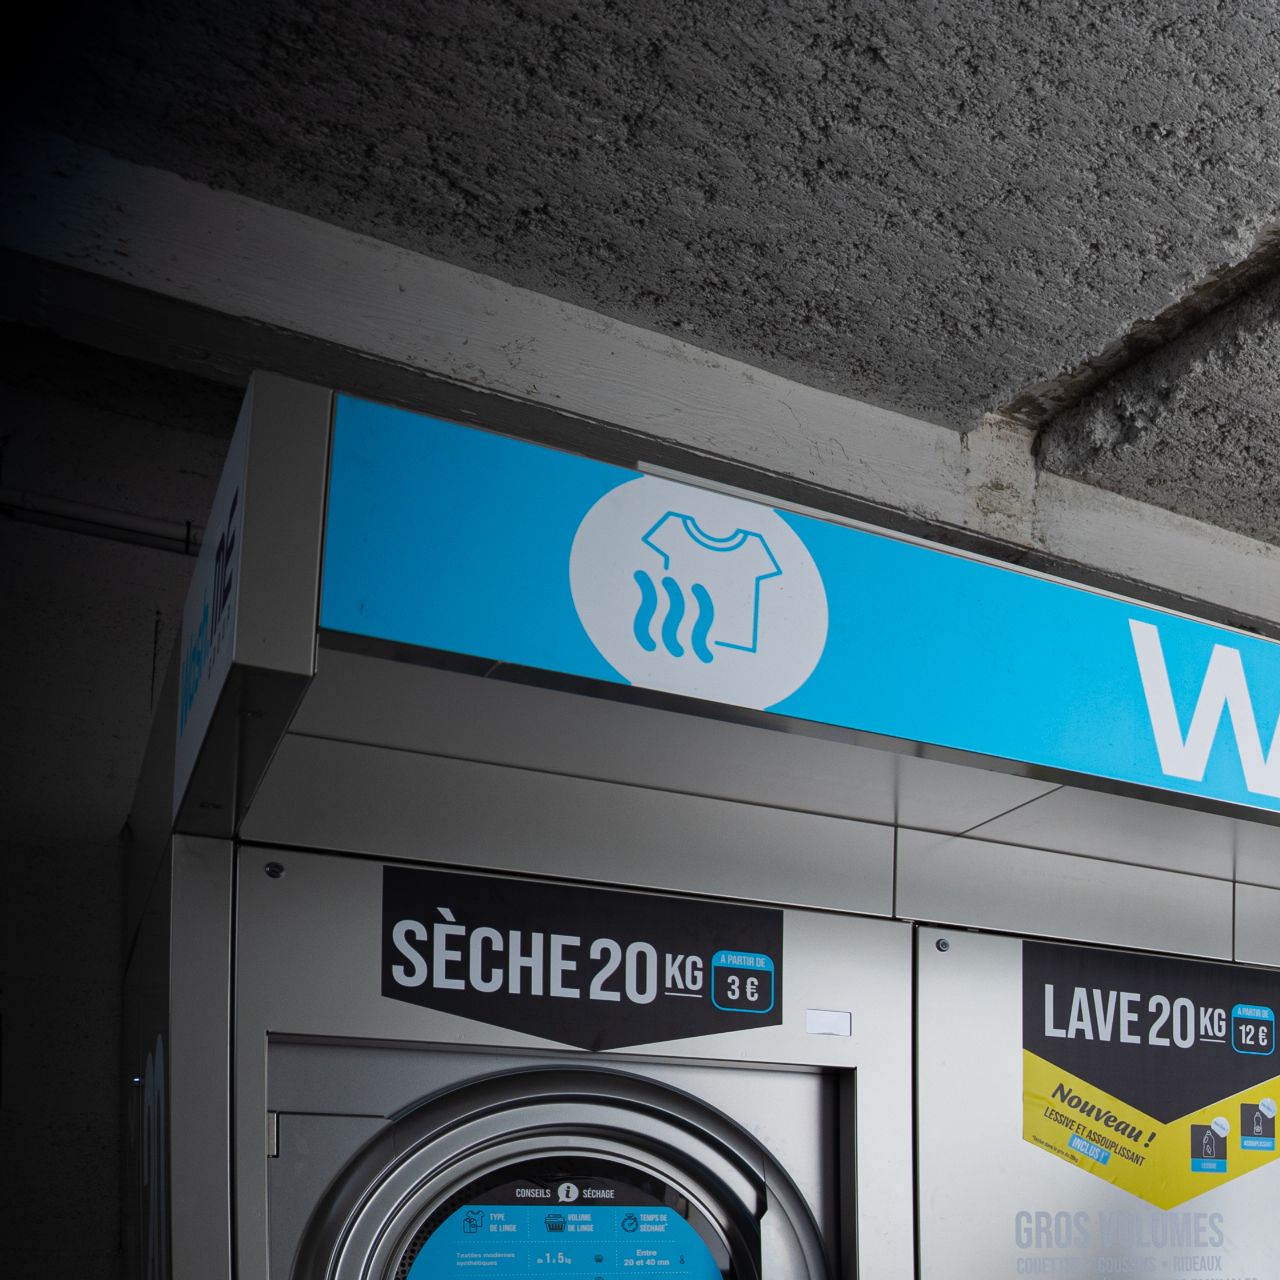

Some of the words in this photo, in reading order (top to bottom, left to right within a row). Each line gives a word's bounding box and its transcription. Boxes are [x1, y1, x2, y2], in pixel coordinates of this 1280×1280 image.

[392, 908, 580, 998] SÈCHE
[589, 938, 657, 1004] 20
[664, 954, 703, 991] KG
[728, 955, 754, 967] PARTIR
[756, 958, 766, 968] DE
[728, 976, 740, 1000] 3
[746, 977, 759, 1001] €
[1045, 983, 1141, 1044] LAVE
[1148, 994, 1195, 1049] 20
[1200, 1007, 1226, 1037] KG
[1239, 1024, 1255, 1045] 12
[1258, 1026, 1268, 1046] €
[1051, 1082, 1142, 1143] Nouveau
[1144, 1132, 1157, 1149] !
[1044, 1106, 1074, 1132] LESSIVE
[1074, 1122, 1086, 1136] ET
[1086, 1128, 1146, 1167] ASSOUPLISSANT
[1072, 1136, 1100, 1160] INCLUS
[516, 1188, 551, 1199] CONSEILS
[583, 1187, 615, 1199] SÉCHAGE
[490, 1213, 505, 1222] TYPE
[568, 1213, 591, 1223] VOLUME
[640, 1214, 659, 1223] TEMPS
[660, 1214, 668, 1223] DE
[490, 1223, 497, 1232] DE
[498, 1223, 517, 1233] LINGE
[568, 1223, 575, 1233] DE
[576, 1223, 594, 1233] LINGE
[1015, 1210, 1090, 1250] GROS
[558, 1252, 564, 1264] 5
[1173, 1256, 1222, 1272] RIDEAUX
